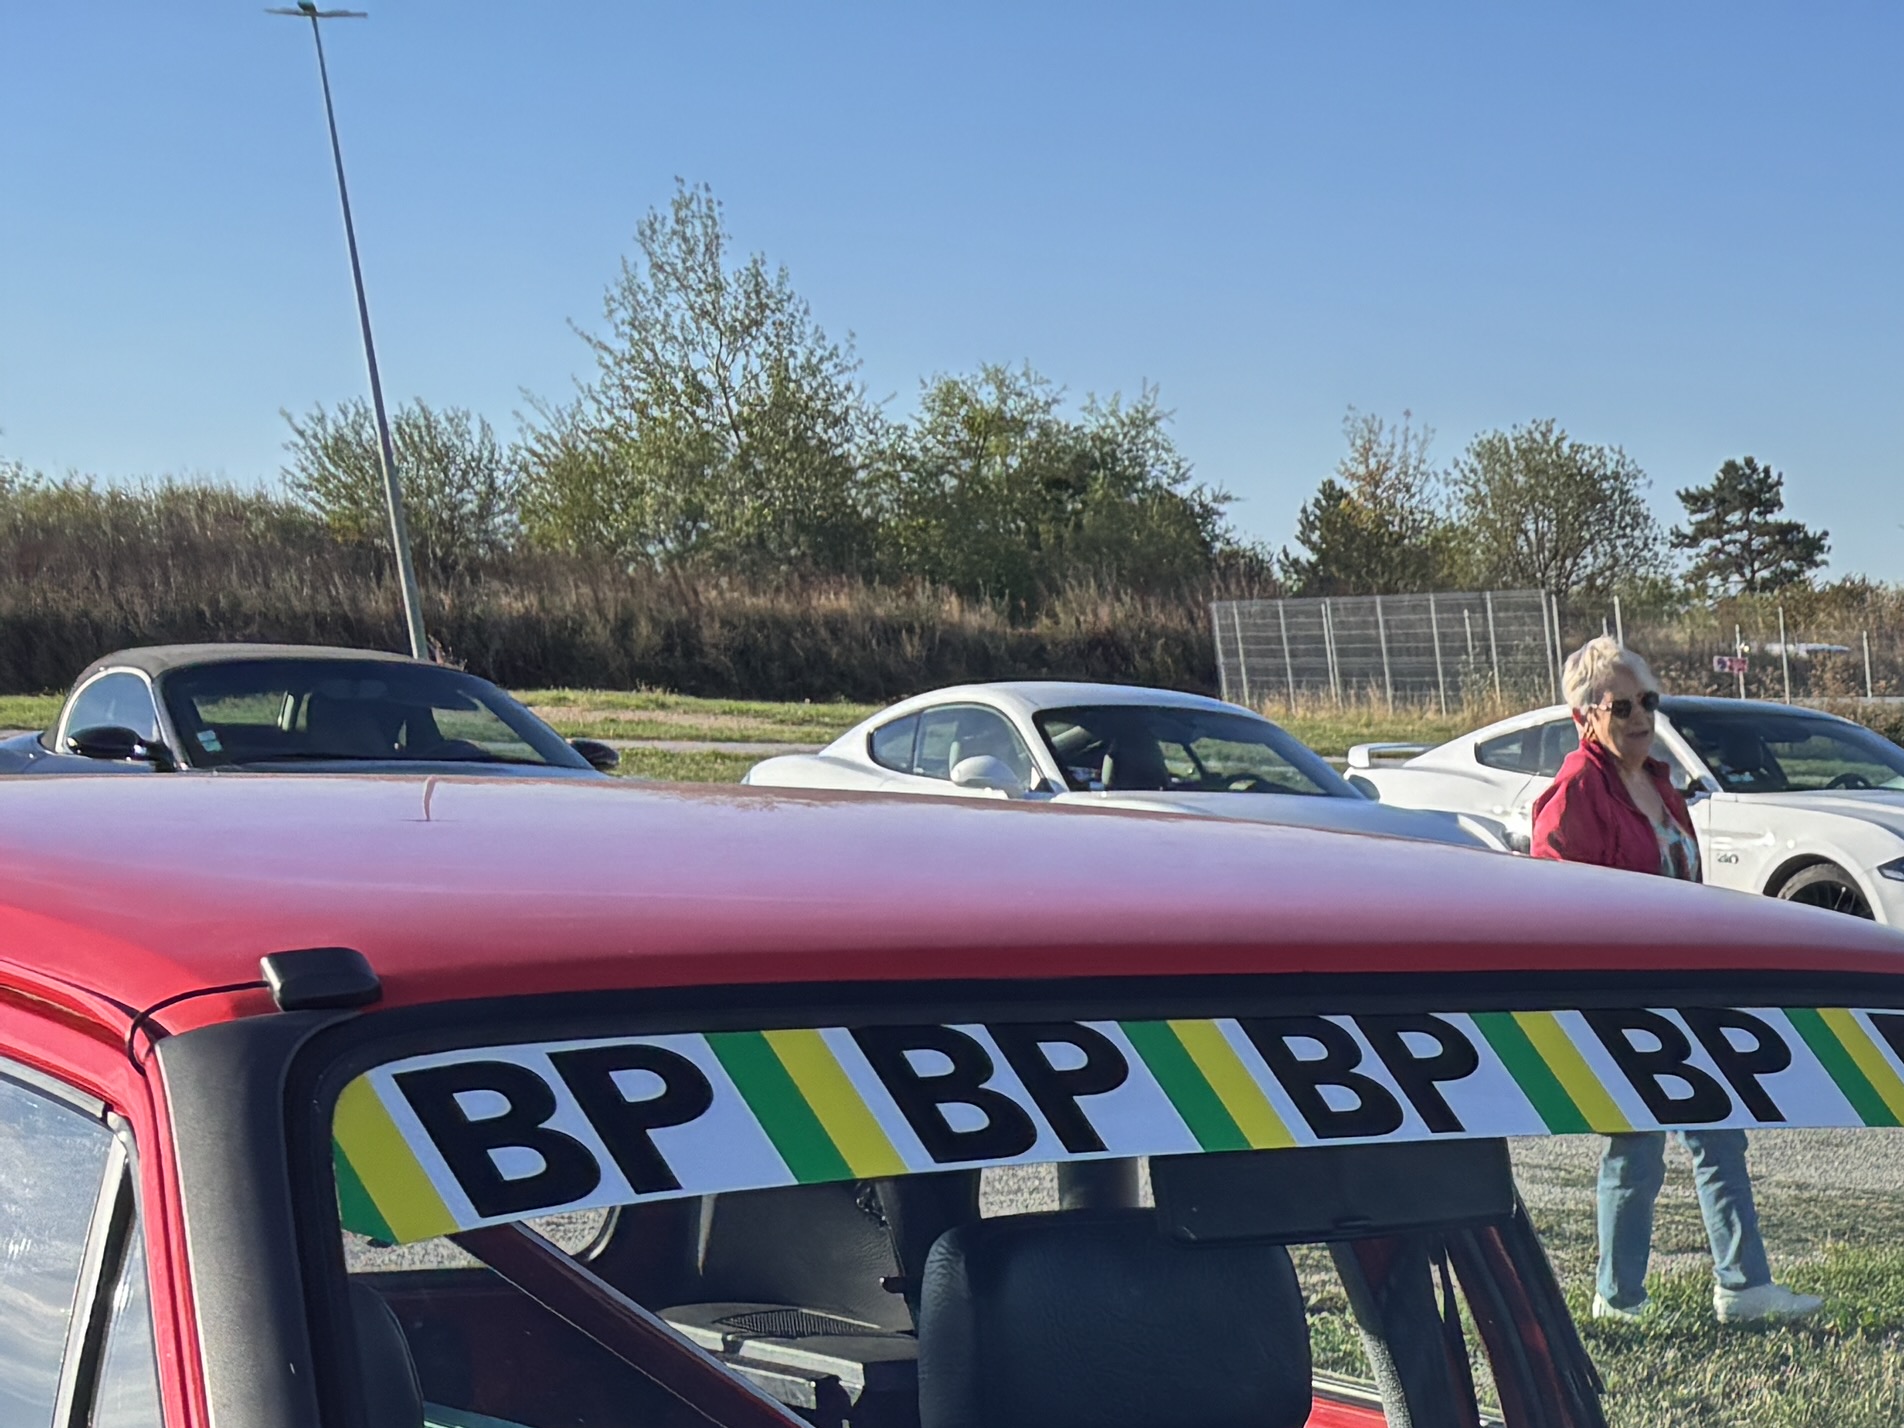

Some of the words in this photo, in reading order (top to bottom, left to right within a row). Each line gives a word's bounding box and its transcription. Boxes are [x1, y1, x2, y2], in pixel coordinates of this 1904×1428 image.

[391, 1044, 713, 1218] BP
[846, 1021, 1129, 1163] BP
[1236, 1013, 1479, 1138] BP
[1575, 1008, 1792, 1125] BP
